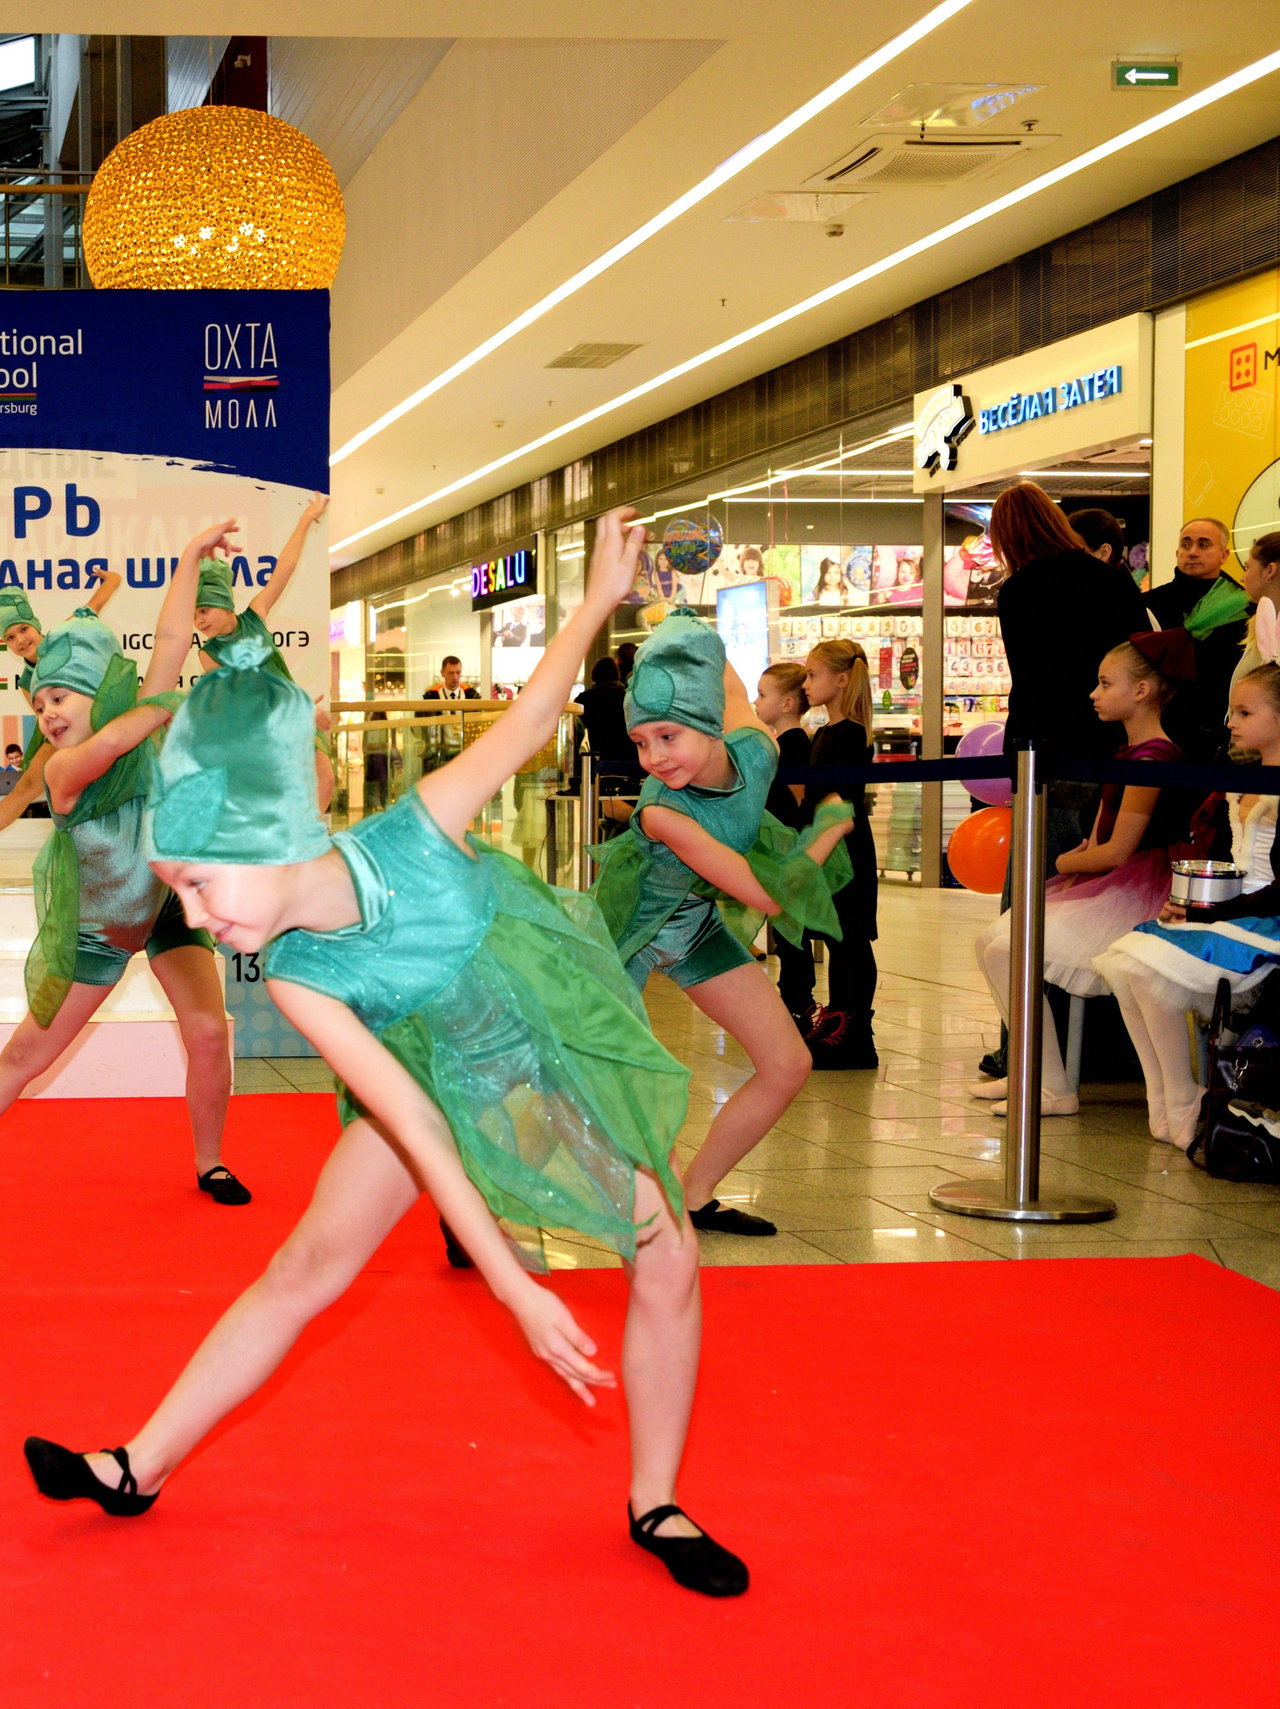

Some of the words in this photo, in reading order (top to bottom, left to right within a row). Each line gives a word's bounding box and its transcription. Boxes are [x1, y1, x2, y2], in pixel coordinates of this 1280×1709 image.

[204, 323, 278, 370] ОХТА
[978, 386, 1057, 434] ВЕСЁЛАЯ
[1058, 365, 1122, 410] ЗАТЕЯ
[126, 555, 279, 589] шла
[471, 550, 526, 598] DESALU
